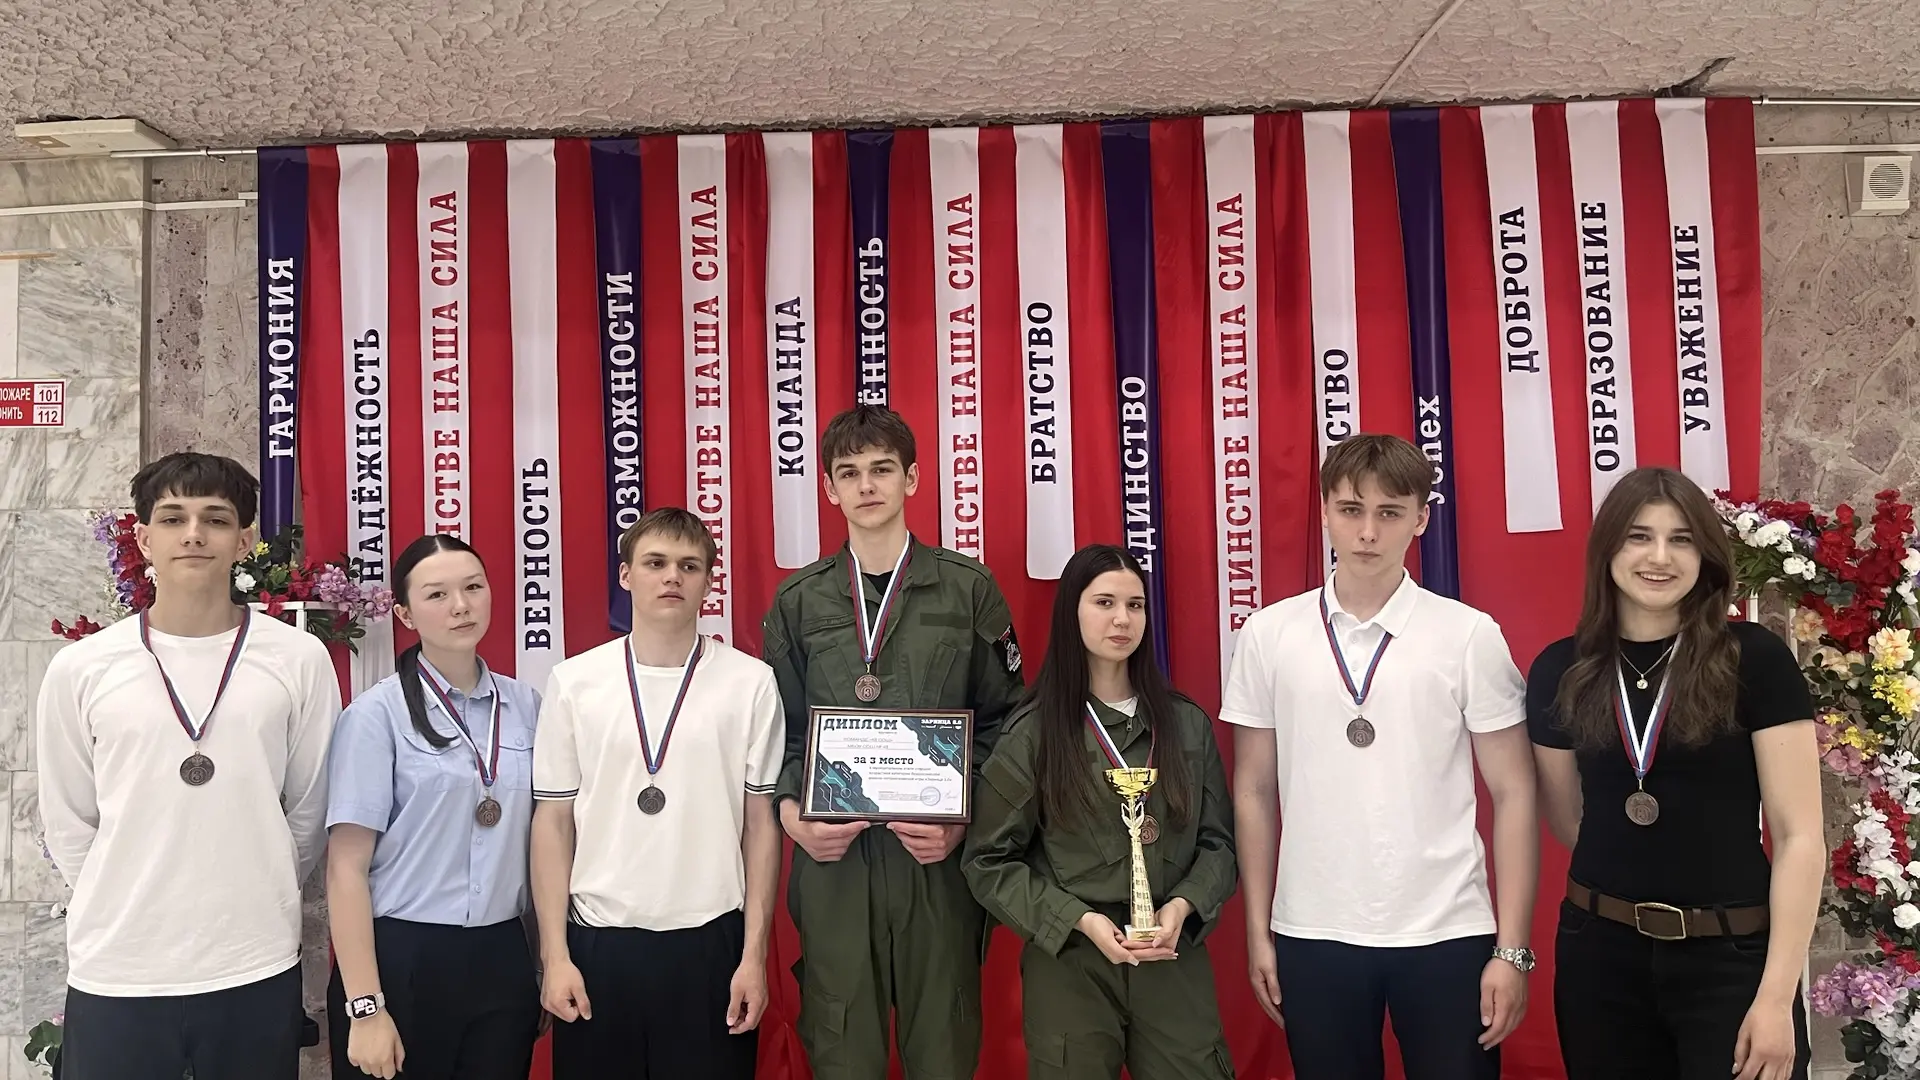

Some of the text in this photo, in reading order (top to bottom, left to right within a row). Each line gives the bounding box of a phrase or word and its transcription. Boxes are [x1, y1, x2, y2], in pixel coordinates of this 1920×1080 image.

[691, 184, 718, 282] СИЛА
[1216, 192, 1245, 291] СИЛА
[1499, 206, 1540, 373] ДОБРОТА
[39, 389, 58, 402] 101
[268, 257, 294, 459] ГАРМОНИЯ
[429, 190, 461, 541] НСТВЕ НАША СИЛА
[694, 295, 721, 409] НАША
[775, 296, 806, 477] КОМАНДА
[857, 237, 887, 406] ЁННОСТЬ
[946, 192, 980, 562] НСТВЕ НАША СИЛА
[1023, 302, 1057, 485] БРАТСТВО
[1219, 304, 1249, 421] НАША
[1581, 201, 1620, 472] ОБРАЗОВАНИЕ
[1674, 224, 1711, 434] УВАЖЕНИЕ
[0, 406, 24, 420] НИТЬ
[38, 410, 58, 423] 112
[352, 328, 385, 583] НАДЁЖНОСТЬ
[522, 458, 551, 651] ВЕРНОСТЬ
[824, 718, 898, 731] ДИПЛОМ
[854, 756, 914, 765] за 3 место
